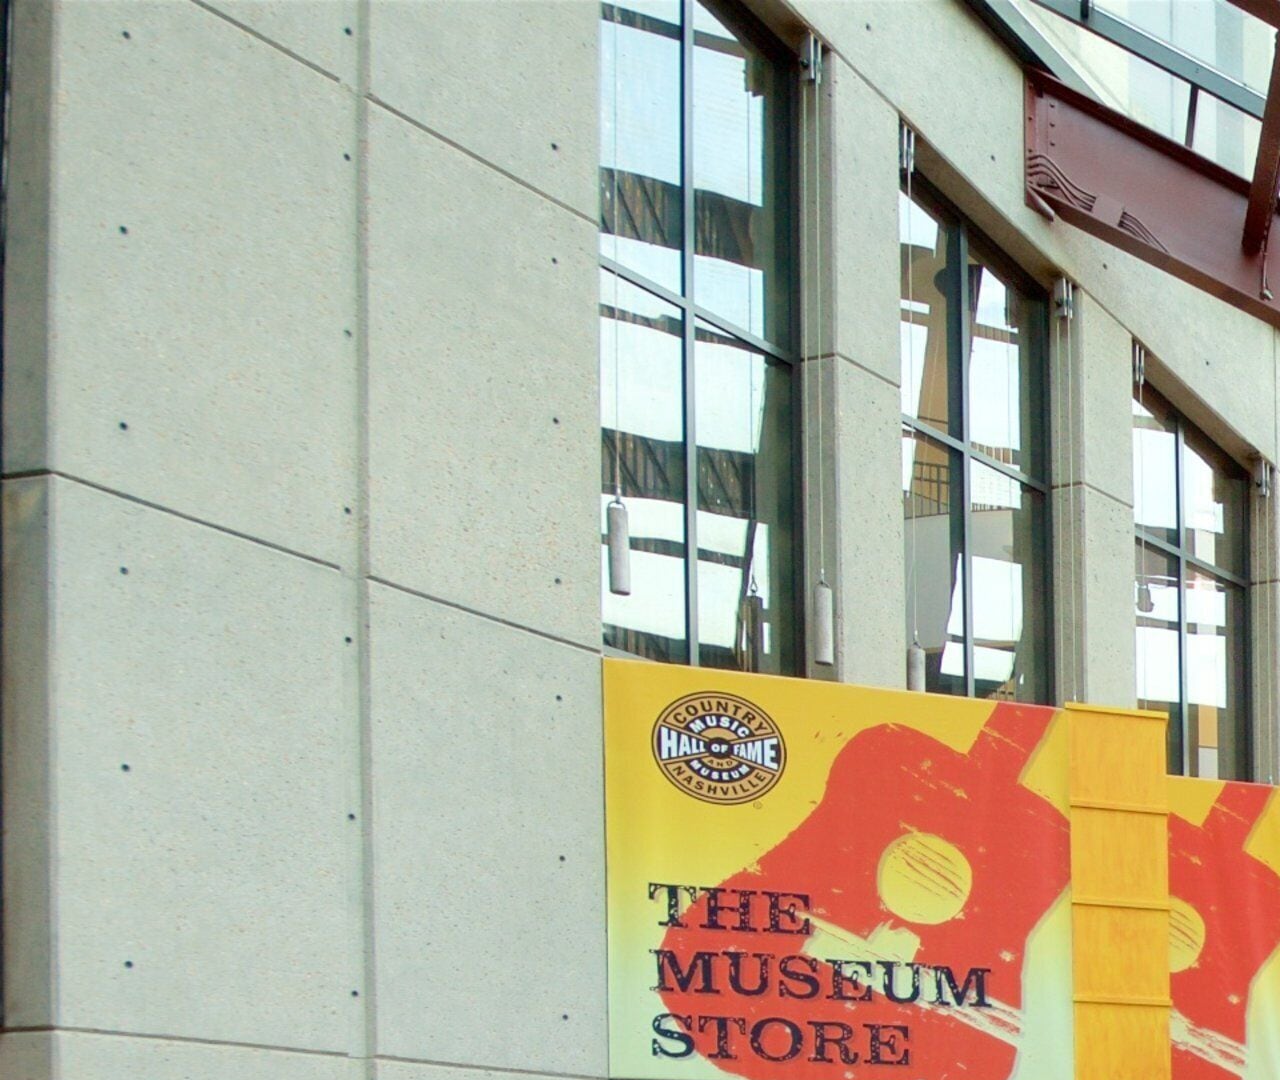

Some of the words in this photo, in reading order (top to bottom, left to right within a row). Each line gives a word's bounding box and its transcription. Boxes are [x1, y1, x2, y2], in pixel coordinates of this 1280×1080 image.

[673, 700, 768, 733] COUNTRY
[689, 715, 750, 738] MUSIC
[660, 725, 706, 760] HALL
[711, 743, 729, 753] OF
[733, 736, 779, 770] FAME
[707, 759, 733, 768] AND
[673, 771, 767, 796] NASHVILLE
[690, 760, 750, 780] MUSEUM
[647, 881, 811, 936] THE
[649, 948, 993, 1009] MUSEUM
[652, 1013, 911, 1067] STORE
